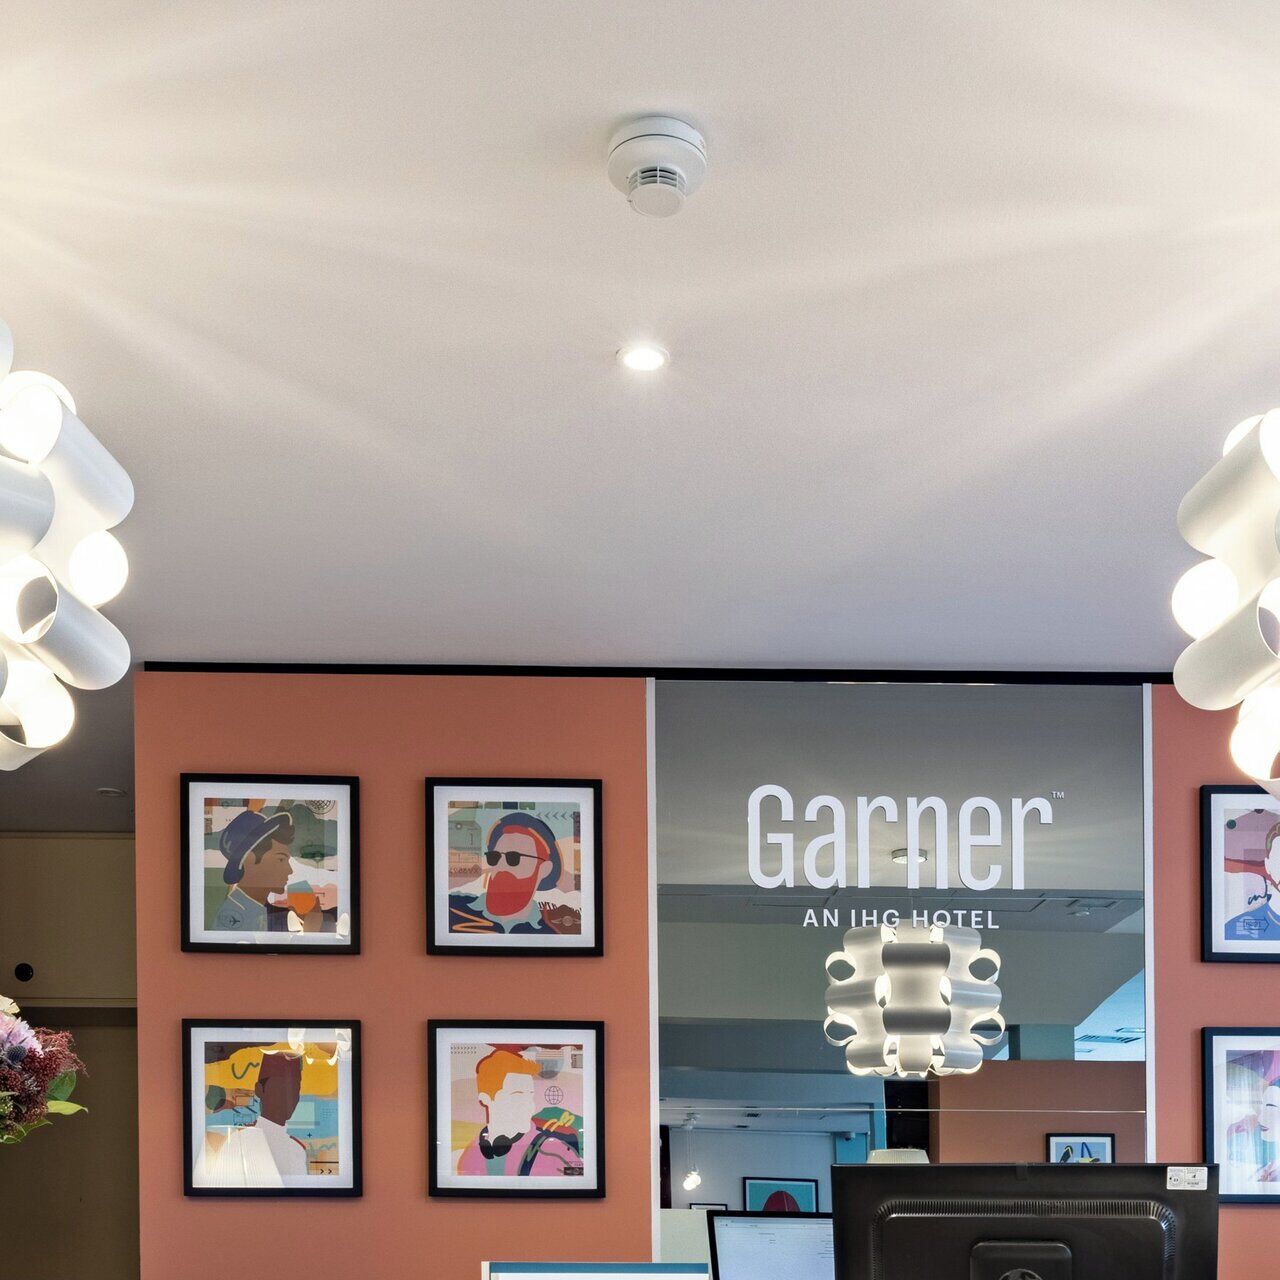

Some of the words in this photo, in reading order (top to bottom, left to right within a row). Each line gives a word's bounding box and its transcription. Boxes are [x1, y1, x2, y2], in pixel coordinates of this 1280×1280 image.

[746, 784, 1053, 891] Garner
[803, 908, 839, 928] AN
[851, 908, 900, 929] IHG
[912, 910, 999, 930] HOTEL
